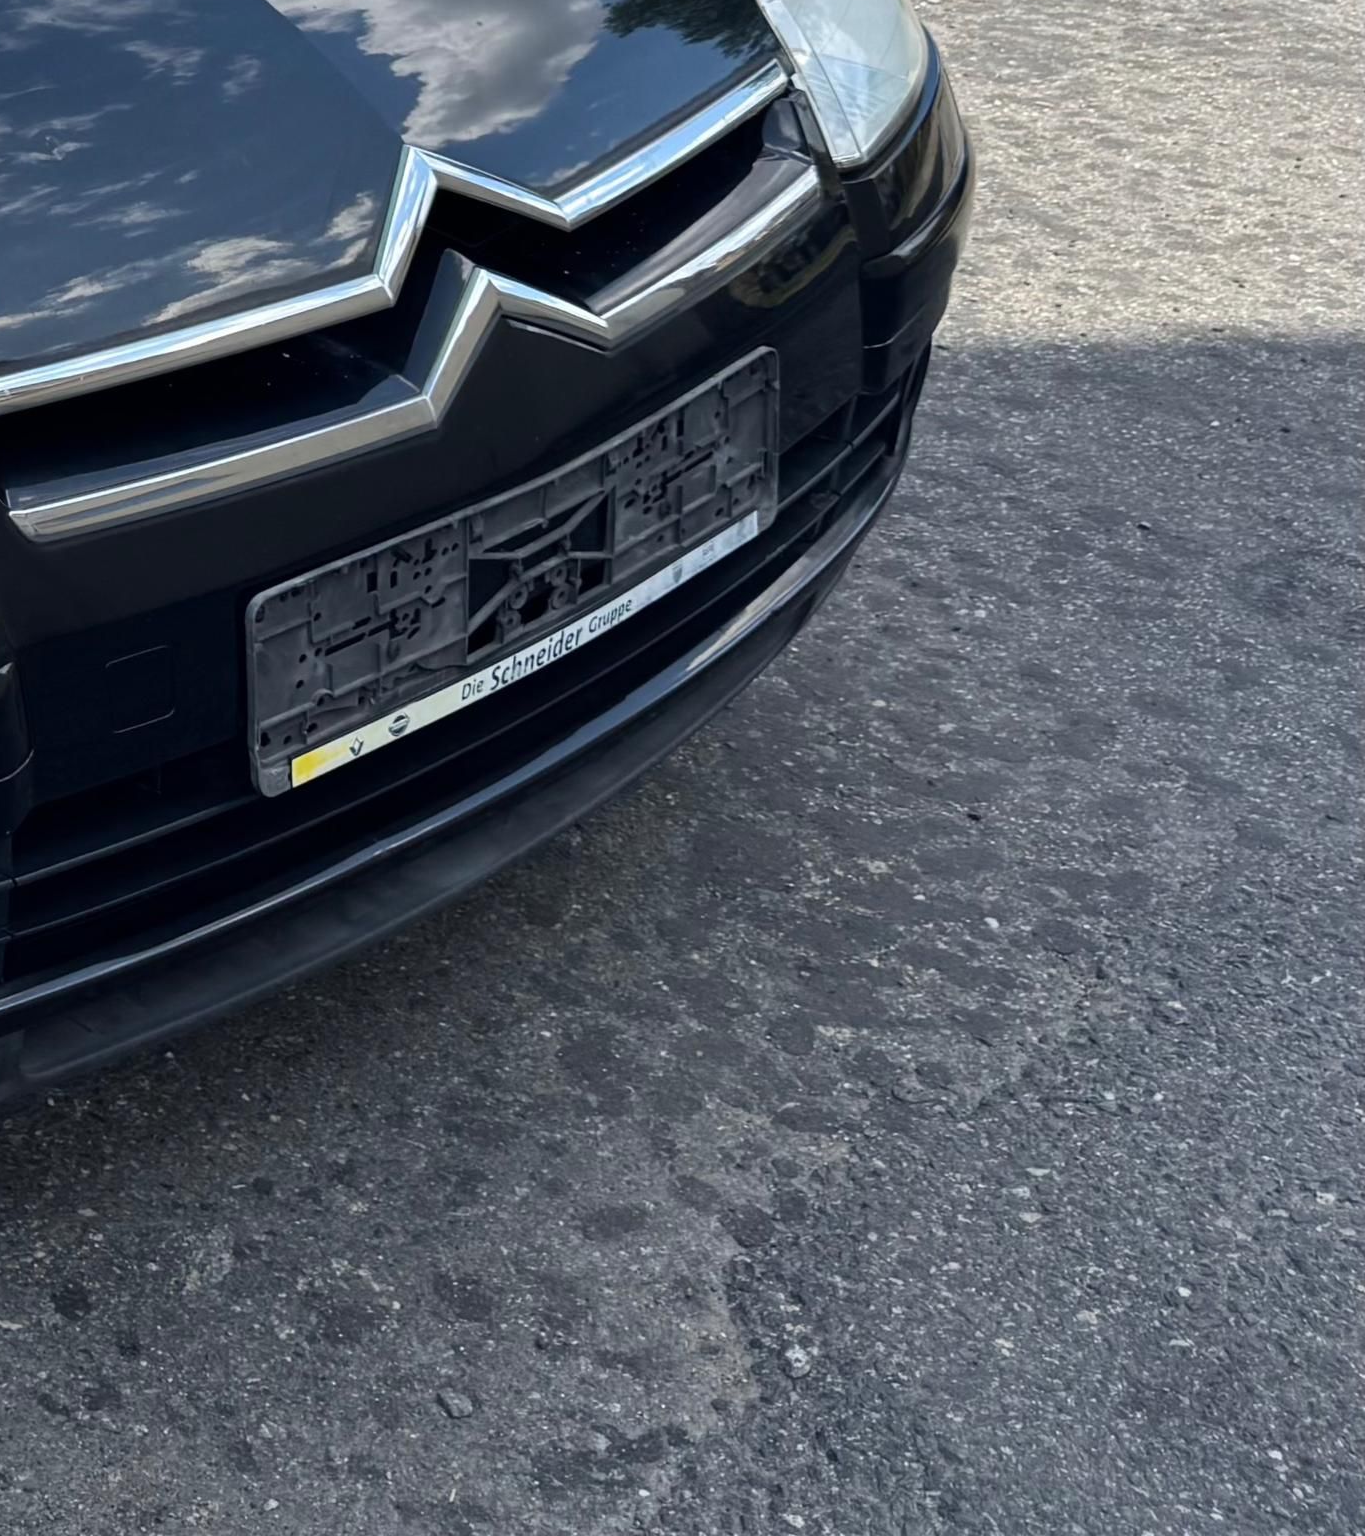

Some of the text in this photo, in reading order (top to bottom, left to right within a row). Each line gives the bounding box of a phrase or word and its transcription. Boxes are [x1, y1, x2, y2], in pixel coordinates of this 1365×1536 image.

[460, 598, 633, 701] Die Schneider Gruppe
